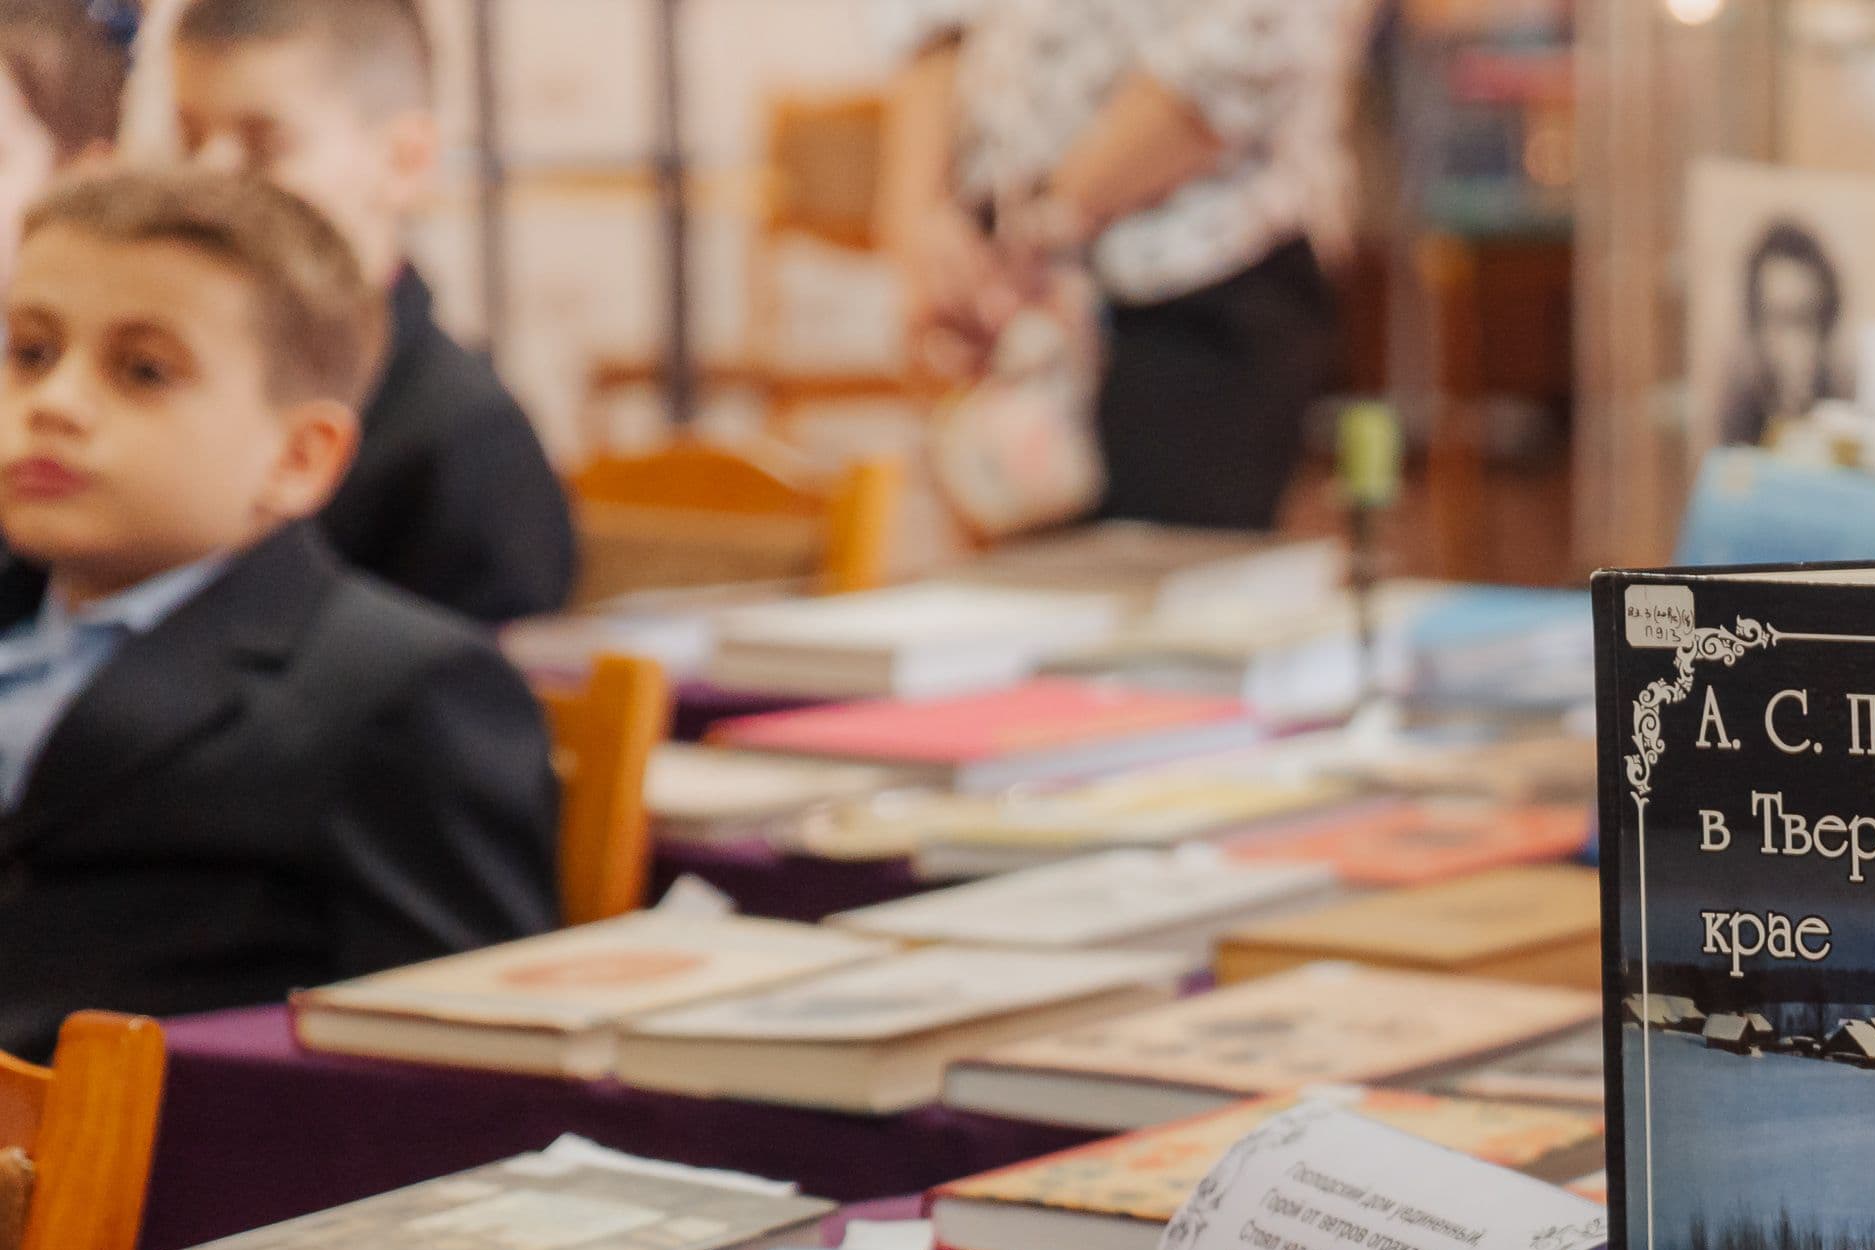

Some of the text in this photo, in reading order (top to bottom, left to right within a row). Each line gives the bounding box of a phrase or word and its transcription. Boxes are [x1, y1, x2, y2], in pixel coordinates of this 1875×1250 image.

[1695, 685, 1741, 750] А.
[1765, 689, 1823, 756] С.
[1699, 808, 1731, 853] в
[1701, 909, 1832, 977] крае
[1360, 1193, 1396, 1214] дом
[1239, 1219, 1282, 1250] Стоял
[1301, 1206, 1321, 1225] от
[1317, 1213, 1369, 1244] ветров
